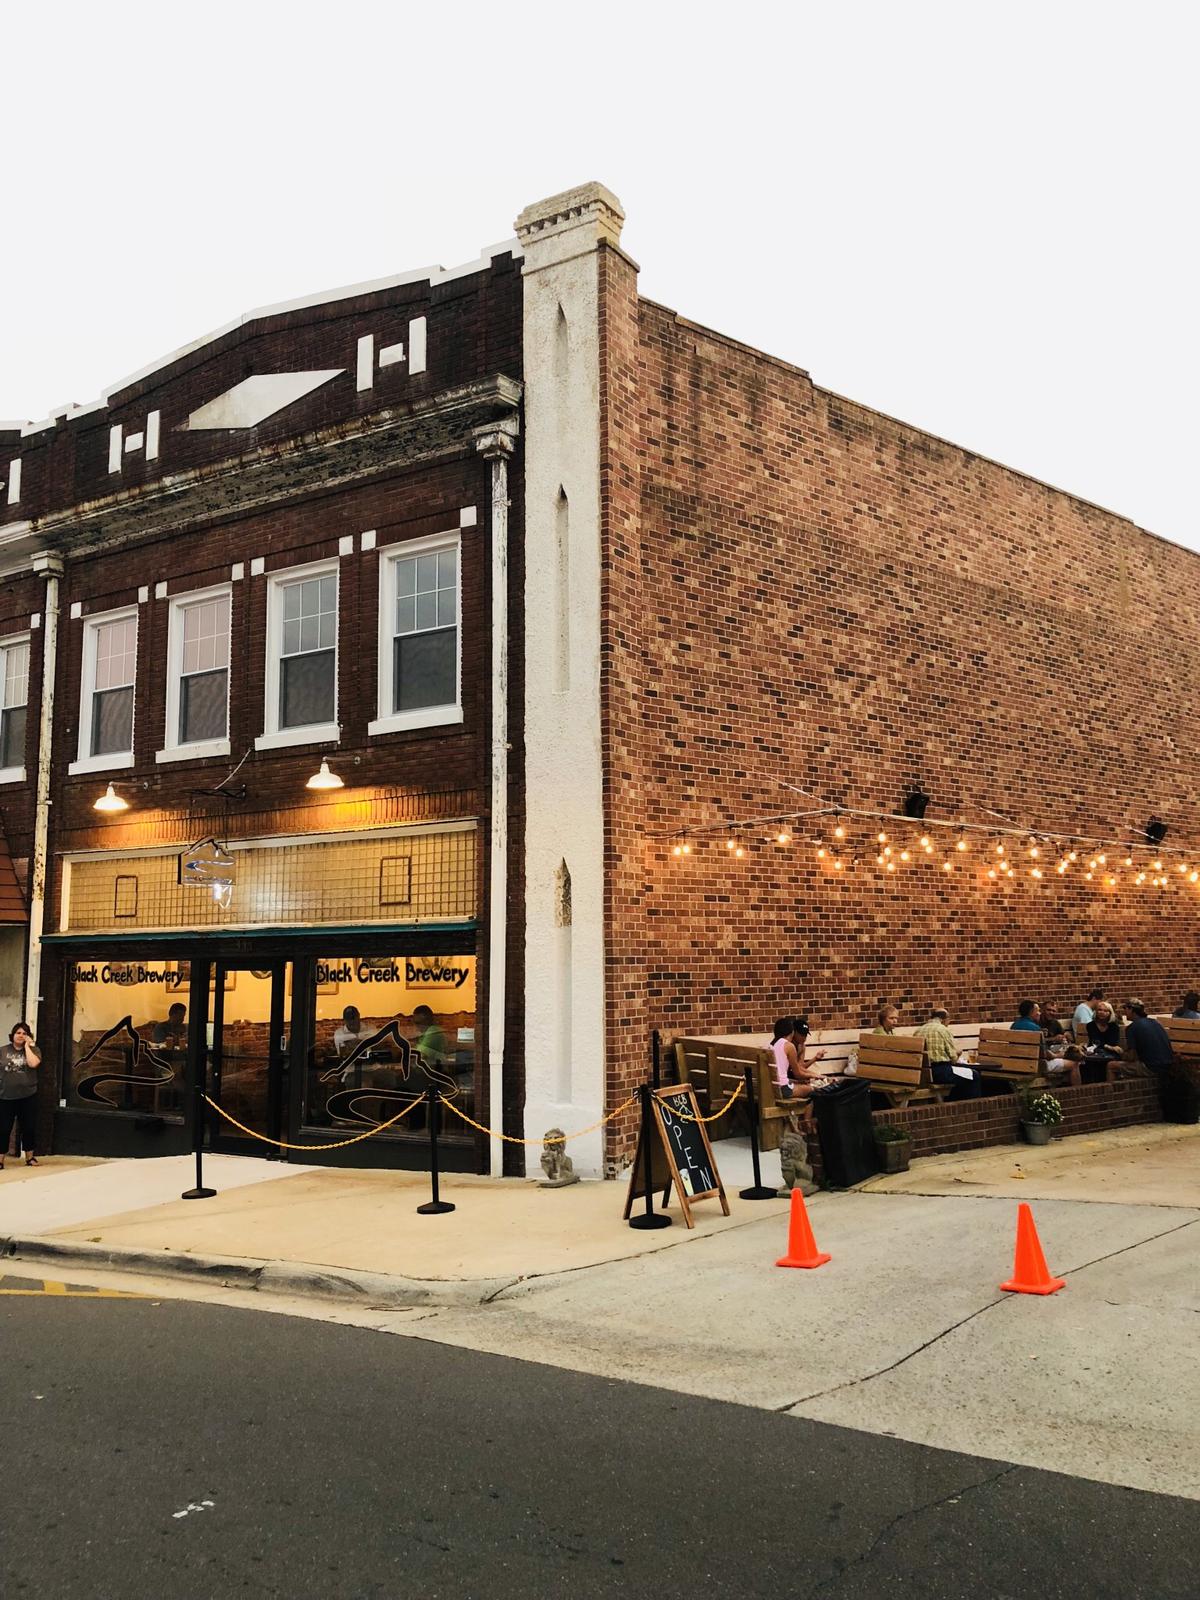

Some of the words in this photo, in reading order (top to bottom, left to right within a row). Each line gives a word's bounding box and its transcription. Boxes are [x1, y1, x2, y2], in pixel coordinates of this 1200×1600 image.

[70, 965, 98, 983] Black
[101, 965, 133, 984] Creek
[137, 966, 184, 988] Brewery
[316, 962, 352, 983] Black
[357, 962, 400, 983] Creek
[405, 962, 469, 988] Brewery
[661, 1105, 713, 1191] OPEN
